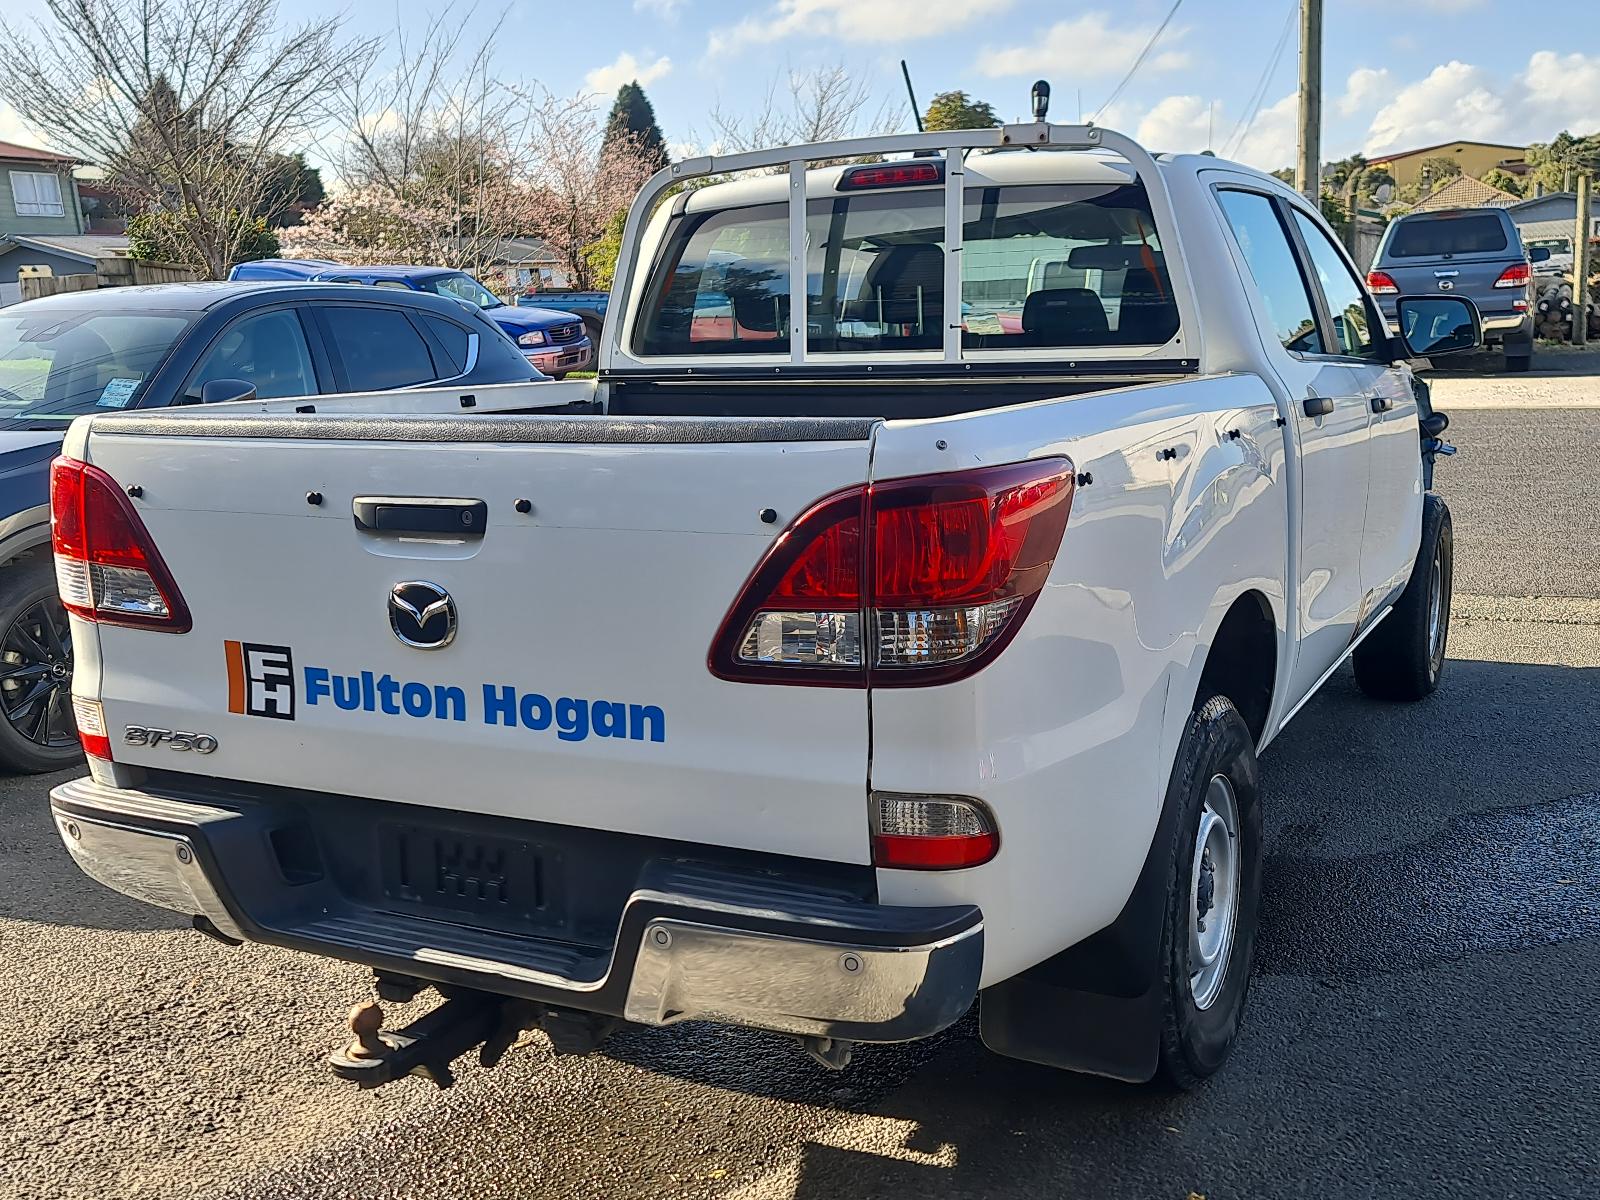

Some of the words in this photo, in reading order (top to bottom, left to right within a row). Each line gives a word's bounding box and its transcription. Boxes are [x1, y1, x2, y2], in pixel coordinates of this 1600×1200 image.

[304, 666, 466, 722] Fulton
[482, 683, 665, 742] Hogan
[124, 724, 218, 754] BT-50
